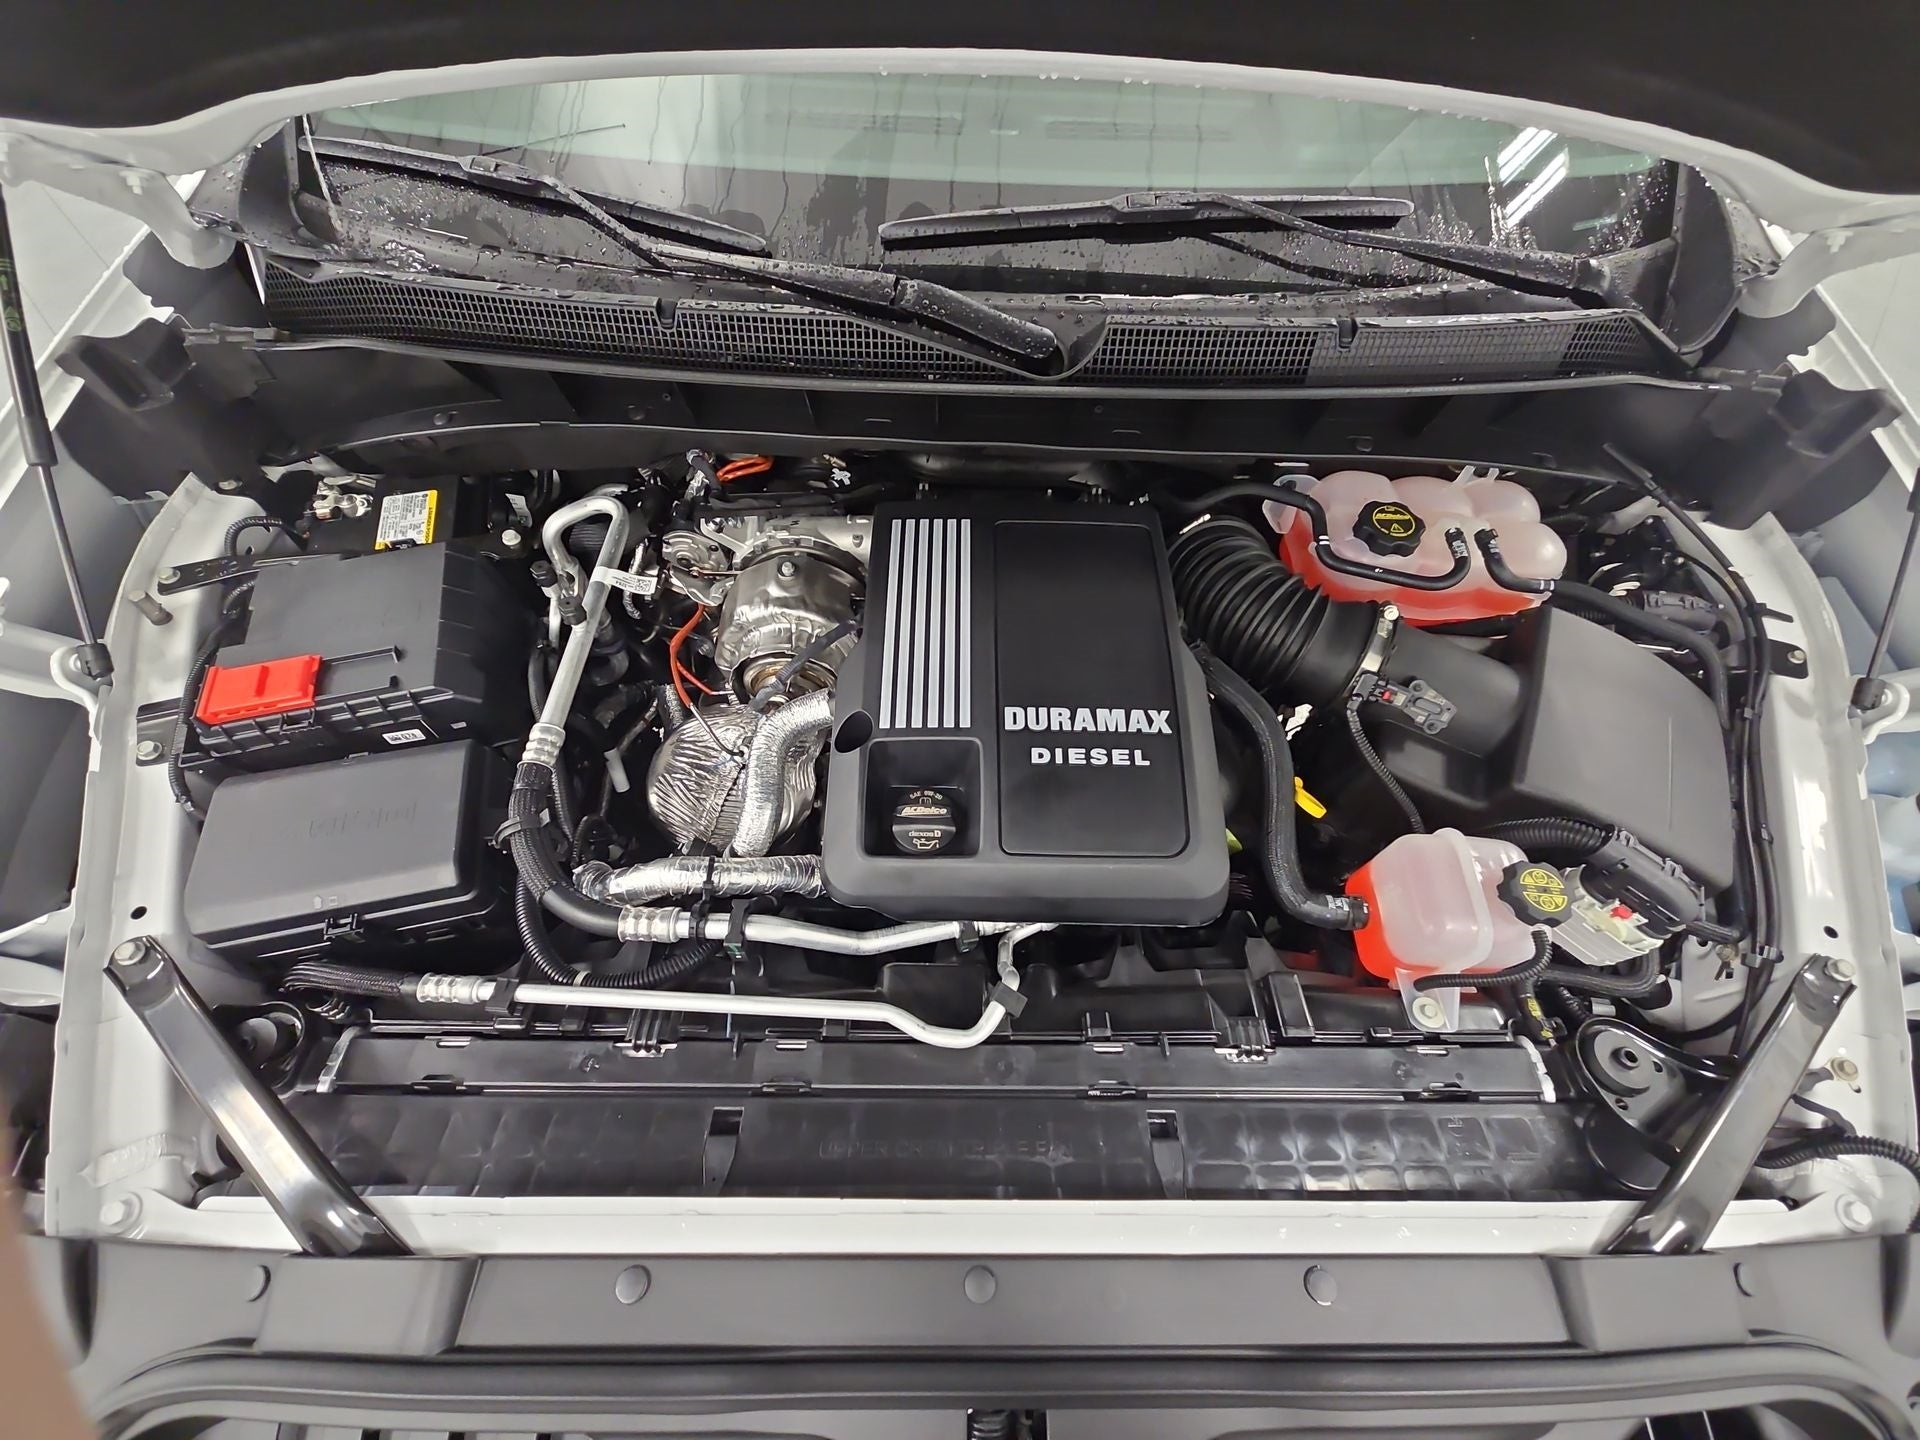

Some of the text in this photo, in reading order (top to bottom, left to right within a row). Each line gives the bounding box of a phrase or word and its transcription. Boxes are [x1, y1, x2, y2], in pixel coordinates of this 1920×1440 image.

[1004, 706, 1172, 734] DURAMAX
[1031, 747, 1150, 766] DIESEL
[909, 791, 921, 800] SAE
[901, 806, 947, 815] ACDelco
